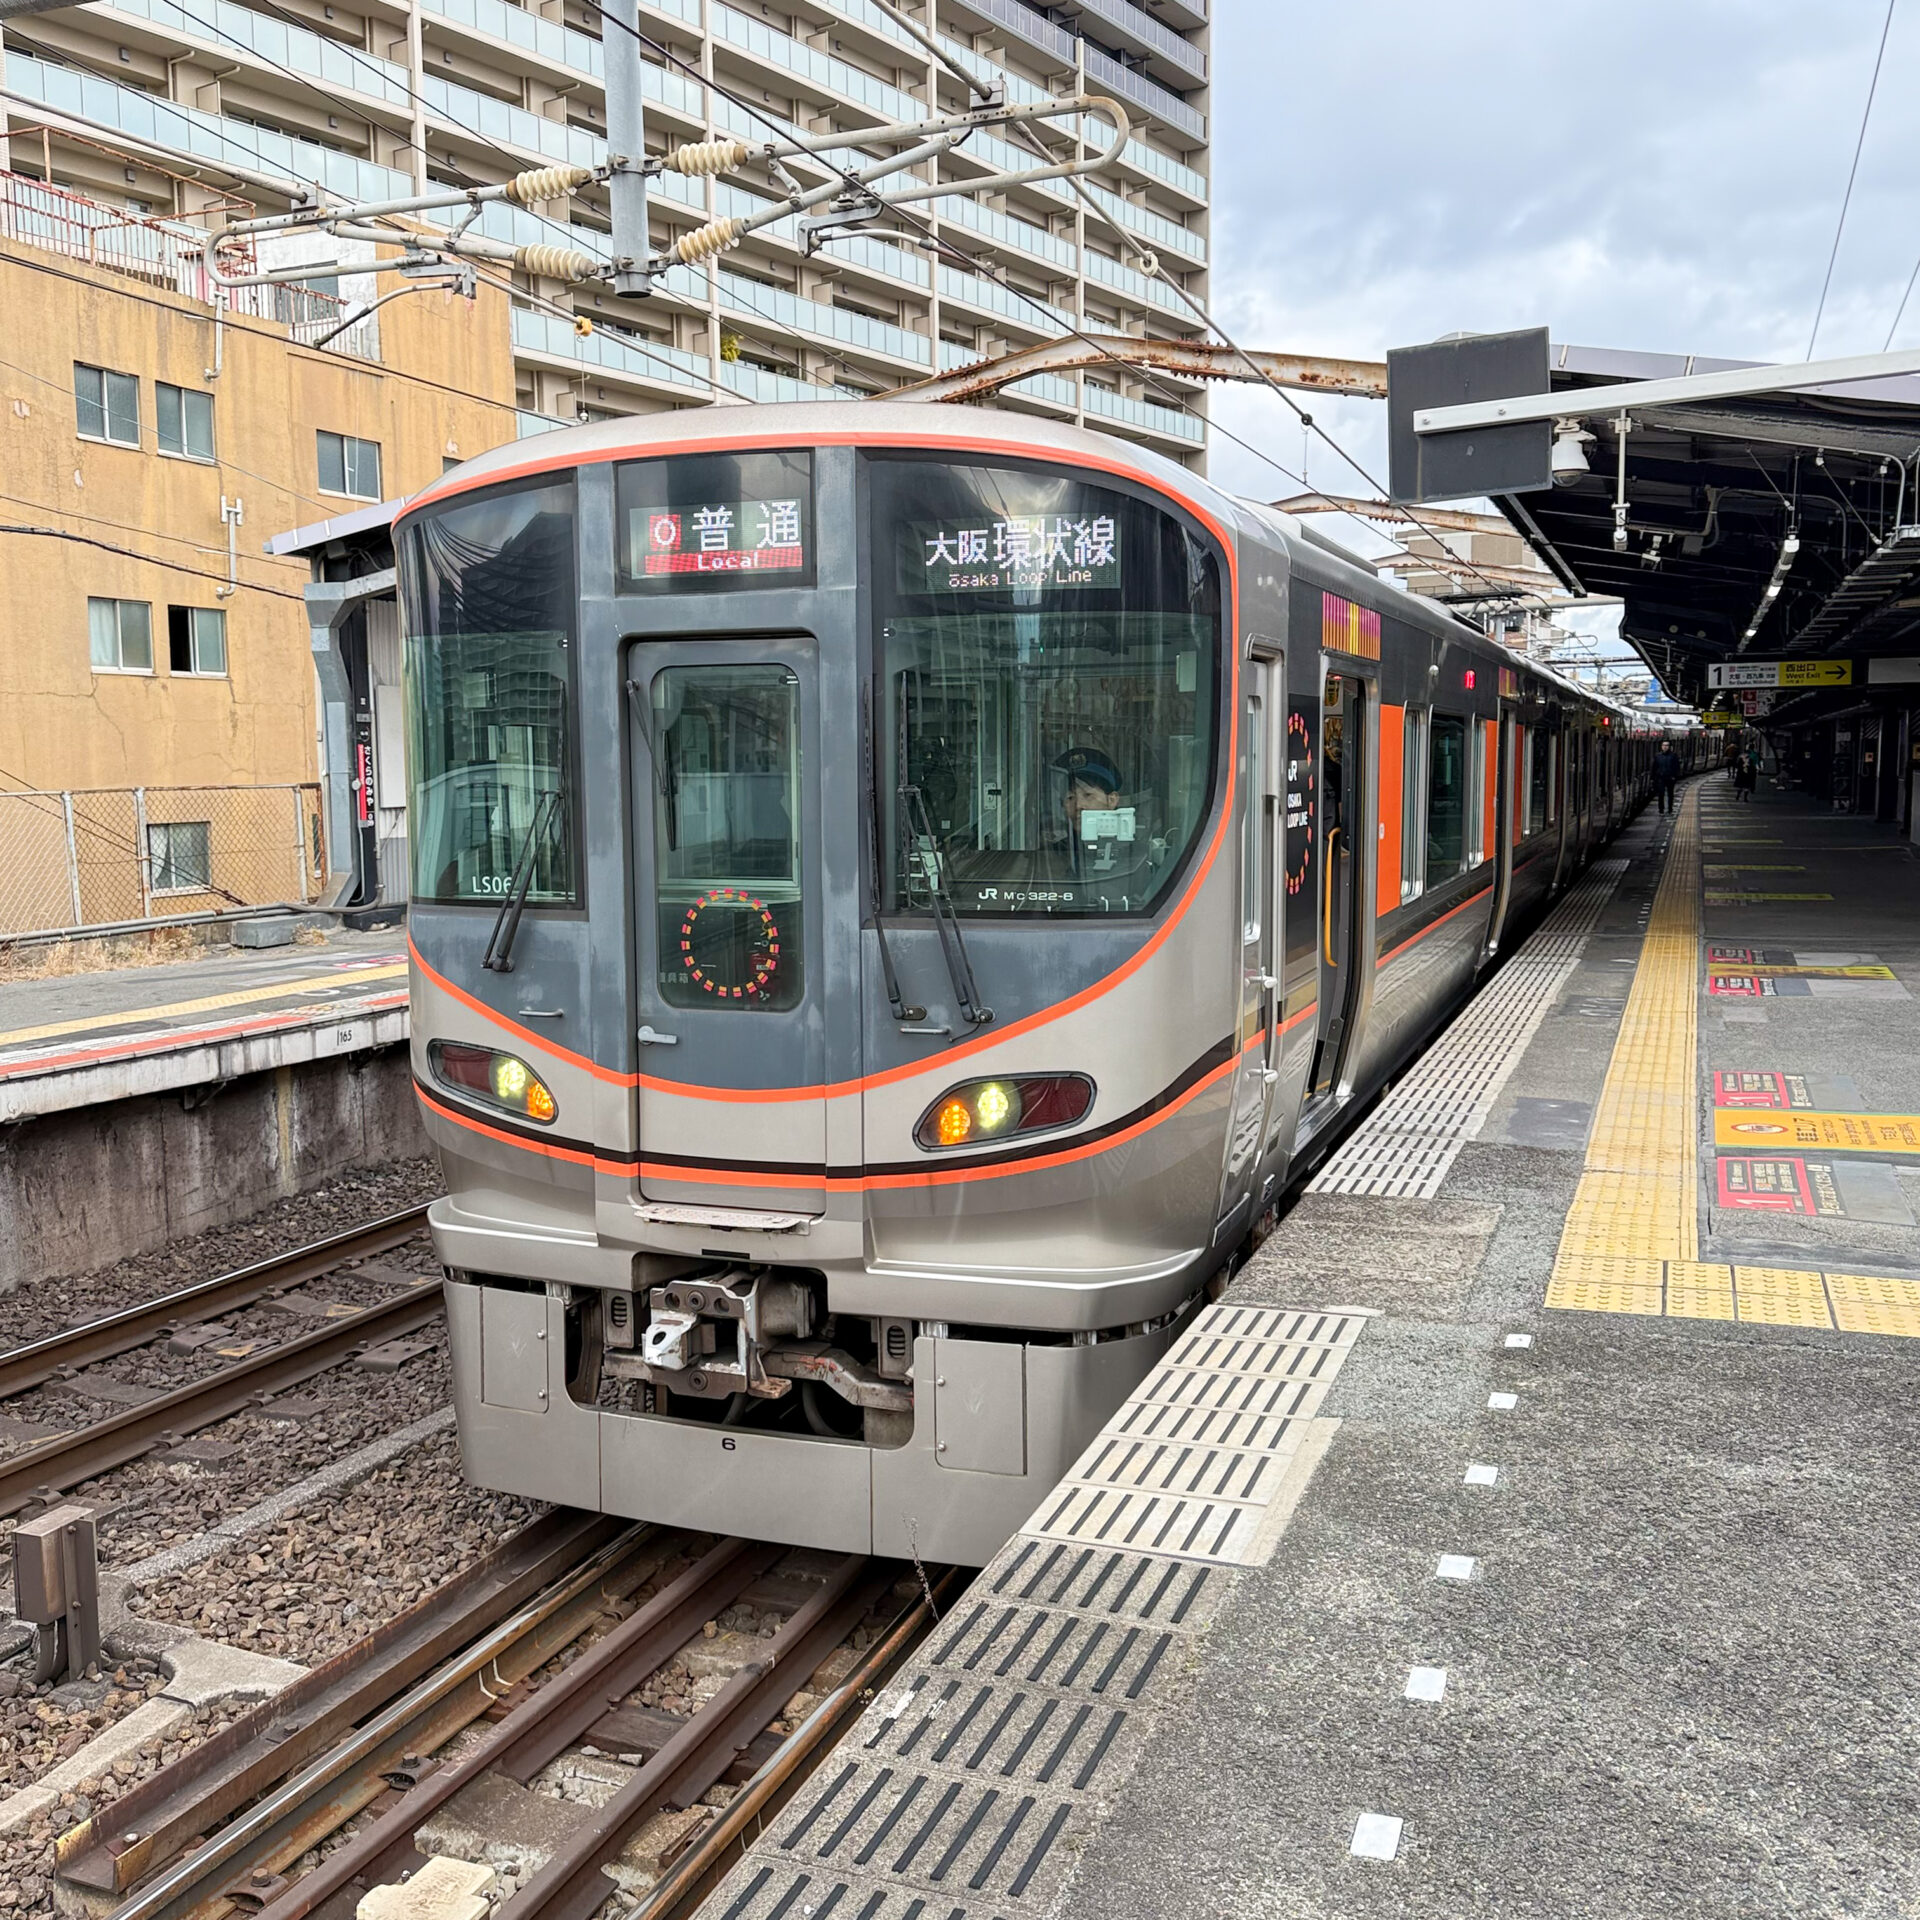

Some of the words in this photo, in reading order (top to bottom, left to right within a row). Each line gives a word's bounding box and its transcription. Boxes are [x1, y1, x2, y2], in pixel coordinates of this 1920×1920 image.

[691, 501, 801, 551] 普通
[925, 515, 1116, 570] 大阪環状線
[698, 551, 758, 570] Local
[1007, 571, 1047, 585] Loop
[1056, 569, 1092, 583] Line
[1713, 666, 1723, 686] 1
[1288, 760, 1298, 781] JR
[979, 888, 998, 900] JR
[340, 1030, 352, 1043] 165
[722, 1437, 736, 1451] 6
